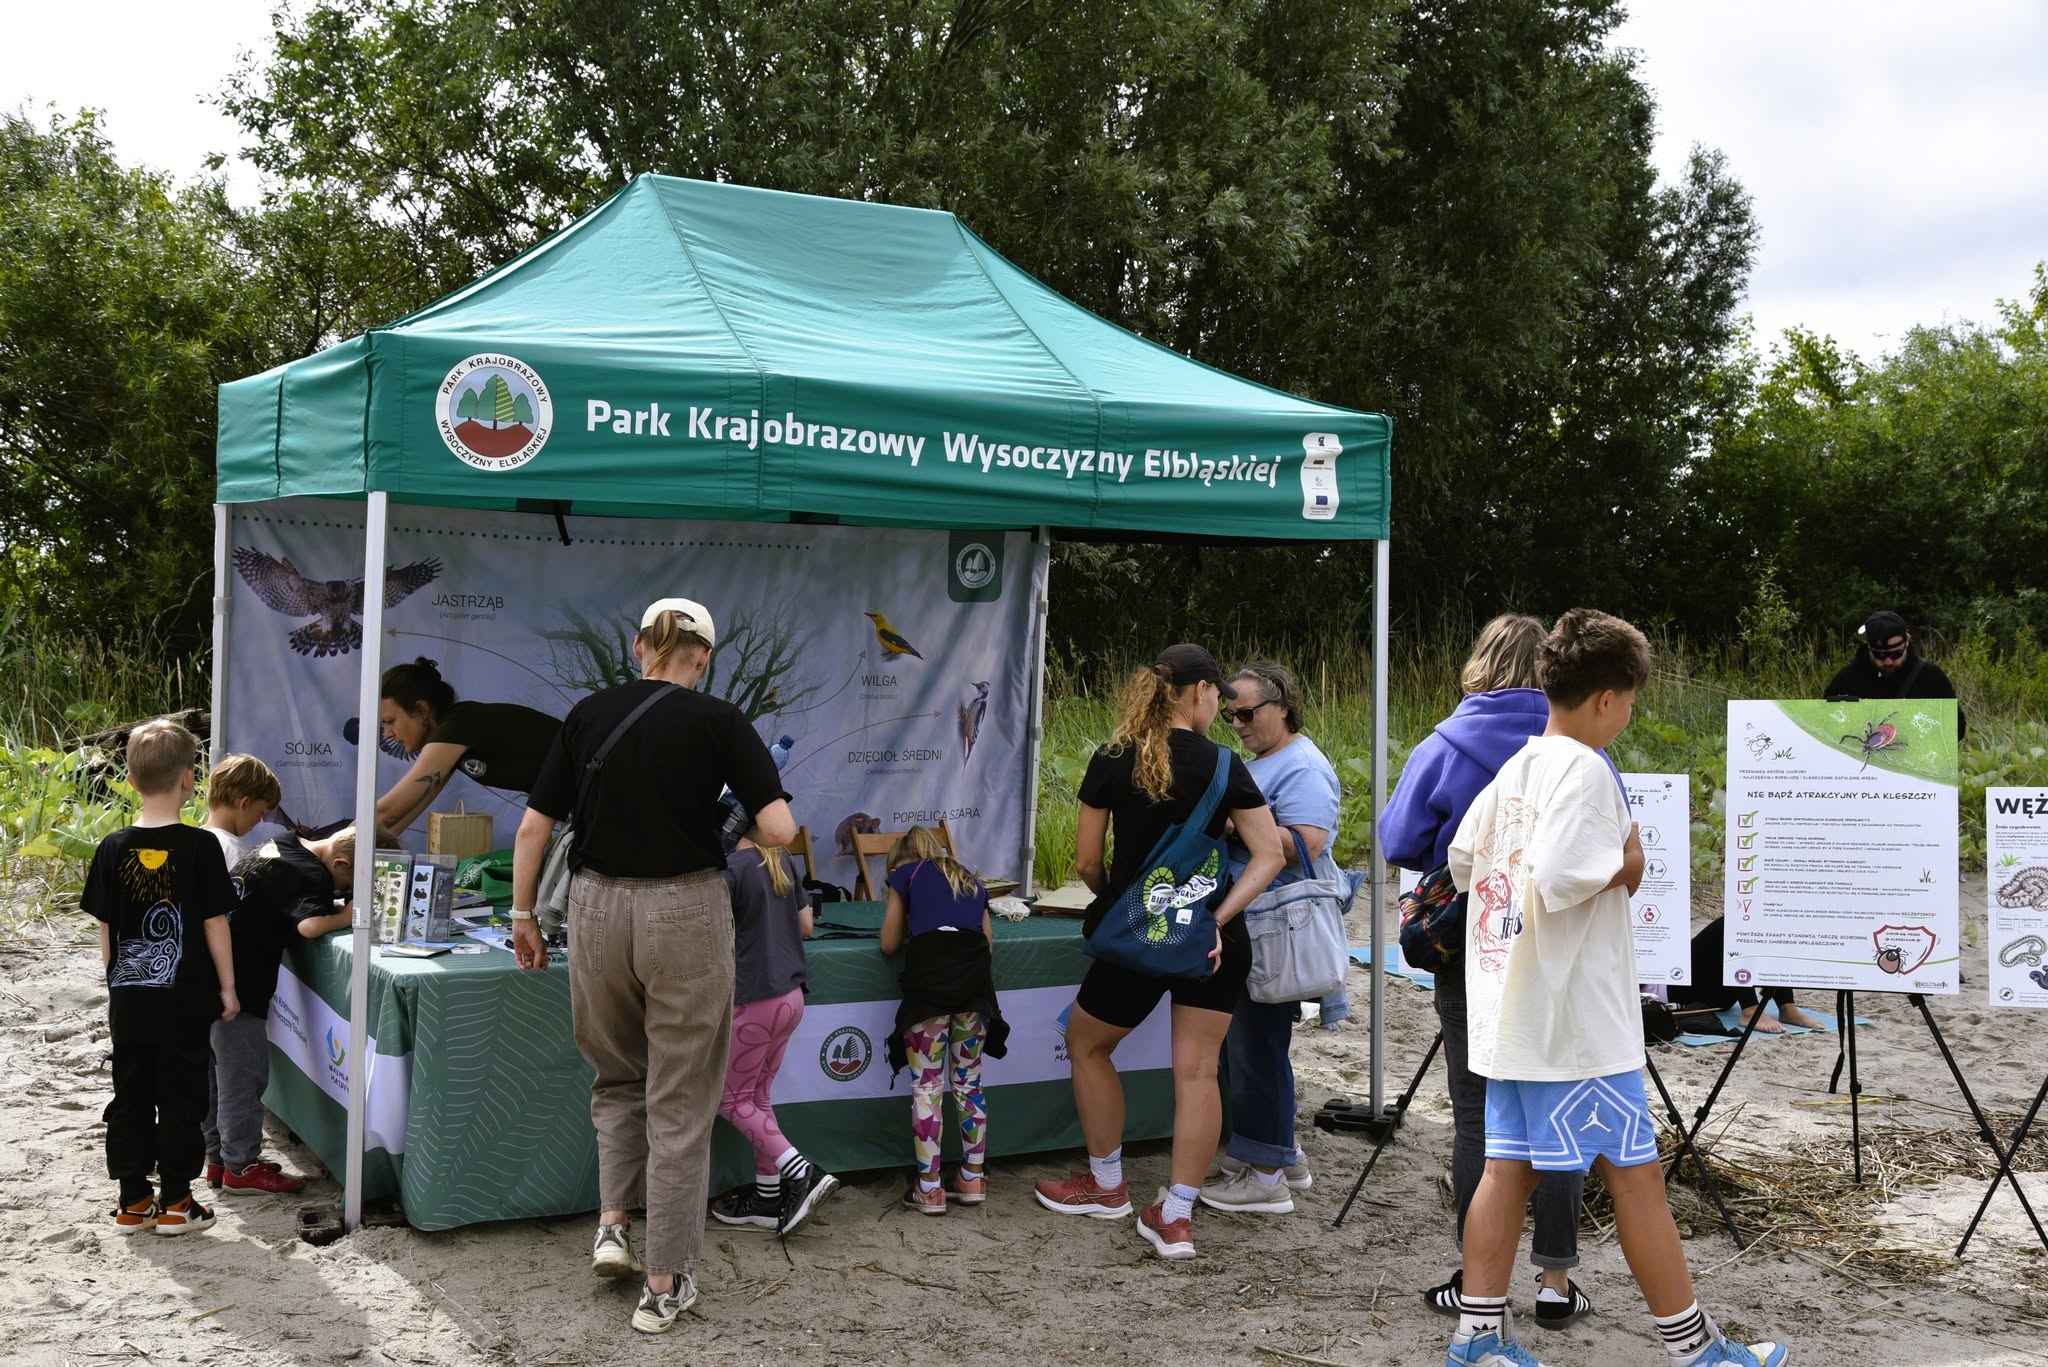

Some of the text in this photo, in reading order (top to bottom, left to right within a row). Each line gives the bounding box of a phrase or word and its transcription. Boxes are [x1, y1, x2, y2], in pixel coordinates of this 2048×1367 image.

[442, 357, 548, 403] PARK KRAJOBRAZOWY
[441, 419, 493, 468] WYSOCZYZNY
[586, 399, 1282, 489] Park Krajobrazowy Wysoczyzny Elbląskiej
[431, 593, 504, 611] JASTRZĄB
[861, 674, 897, 687] WILGA
[285, 739, 333, 756] SÓJKA
[848, 748, 942, 765] DZIĘCIOŁ ŚREDNI
[1747, 790, 1937, 801] NIE BĄDŹ ATRAKCYJNY DLA KLESZCZY!
[893, 807, 981, 824] POPIELICA SZARA
